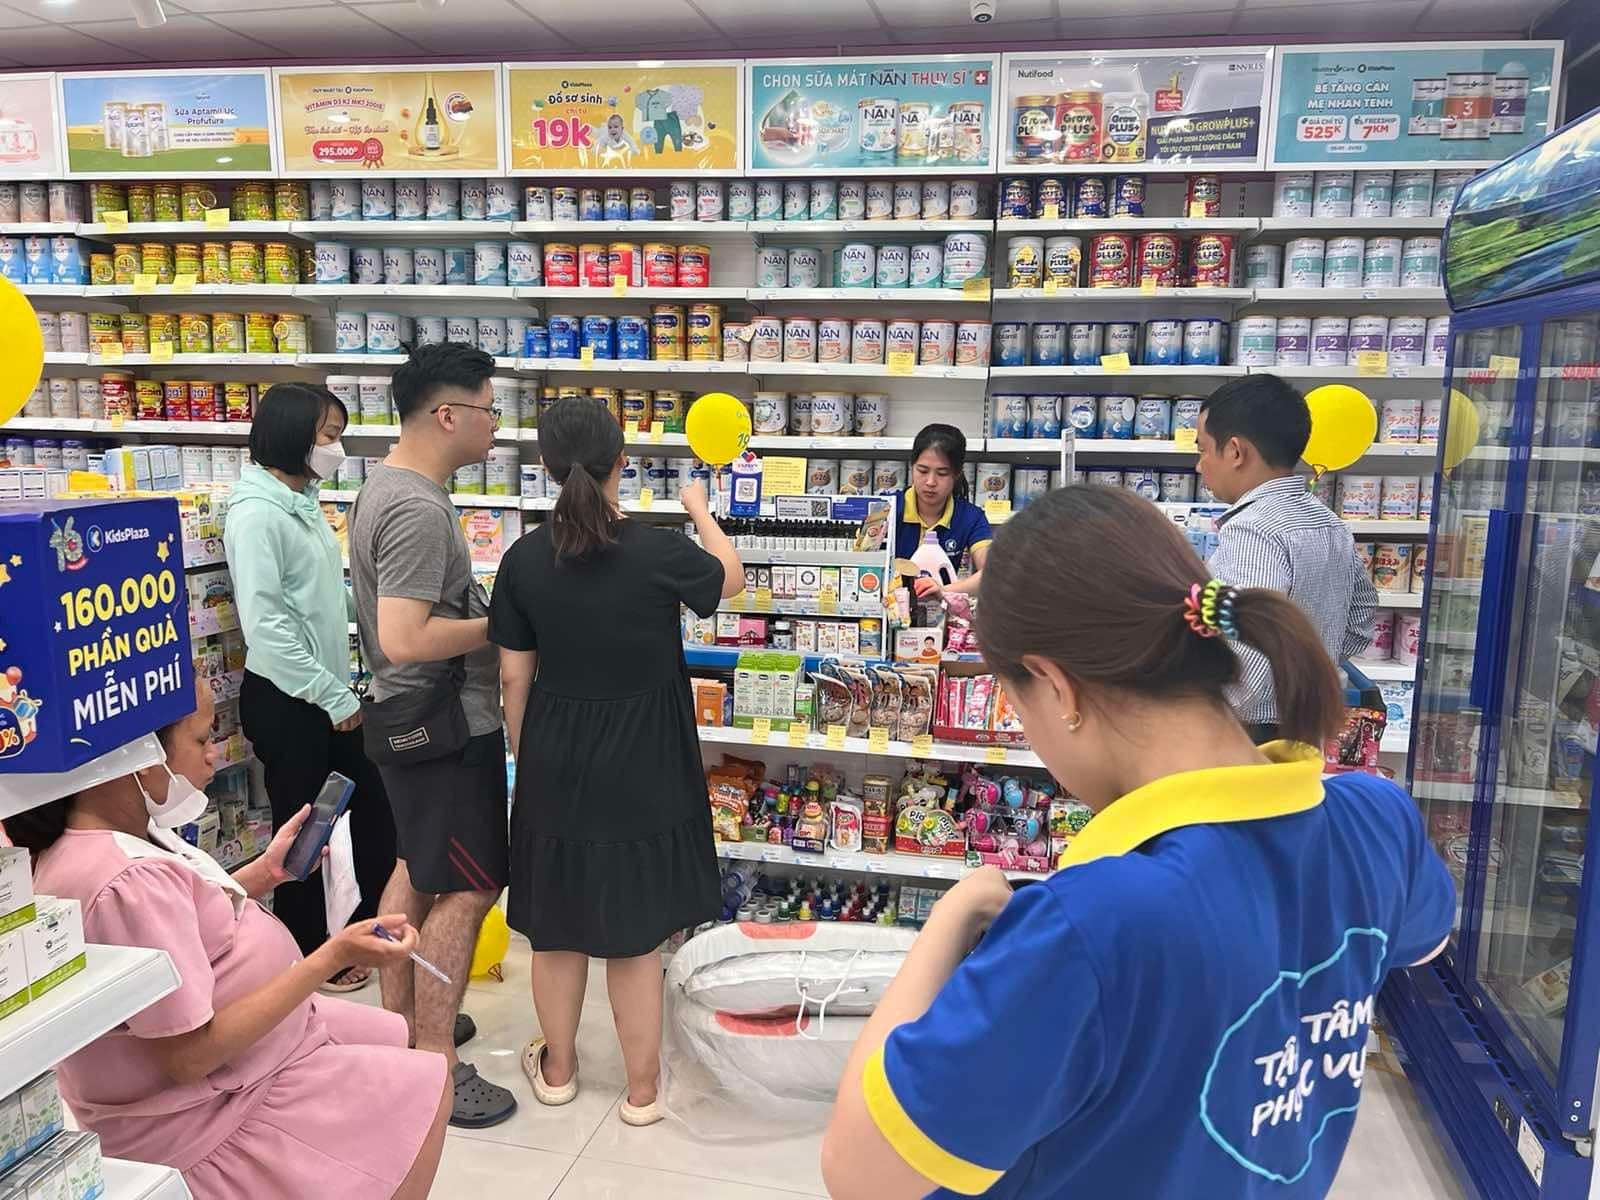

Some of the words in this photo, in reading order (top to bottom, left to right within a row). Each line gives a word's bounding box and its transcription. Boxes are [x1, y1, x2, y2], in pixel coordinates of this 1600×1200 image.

[1018, 69, 1054, 78] Nutifood
[566, 94, 578, 102] sơ
[581, 92, 602, 104] sinh
[306, 100, 332, 111] VITAMIN
[1462, 101, 1473, 116] 3
[1500, 102, 1510, 114] 2
[533, 118, 592, 148] 19k
[1304, 126, 1341, 139] 525K
[1363, 125, 1389, 139] 7KM
[370, 322, 396, 332] NAN
[856, 330, 881, 339] NAN
[888, 330, 913, 340] NAN
[104, 526, 150, 544] KidsPlaza
[60, 570, 176, 630] 160.000
[68, 626, 132, 677] PHẦN
[135, 614, 178, 650] QUÀ
[74, 669, 138, 731] MIỄN
[146, 654, 182, 702] PHÍ
[1301, 994, 1374, 1044] TÂM
[1323, 1045, 1368, 1089] VỤ
